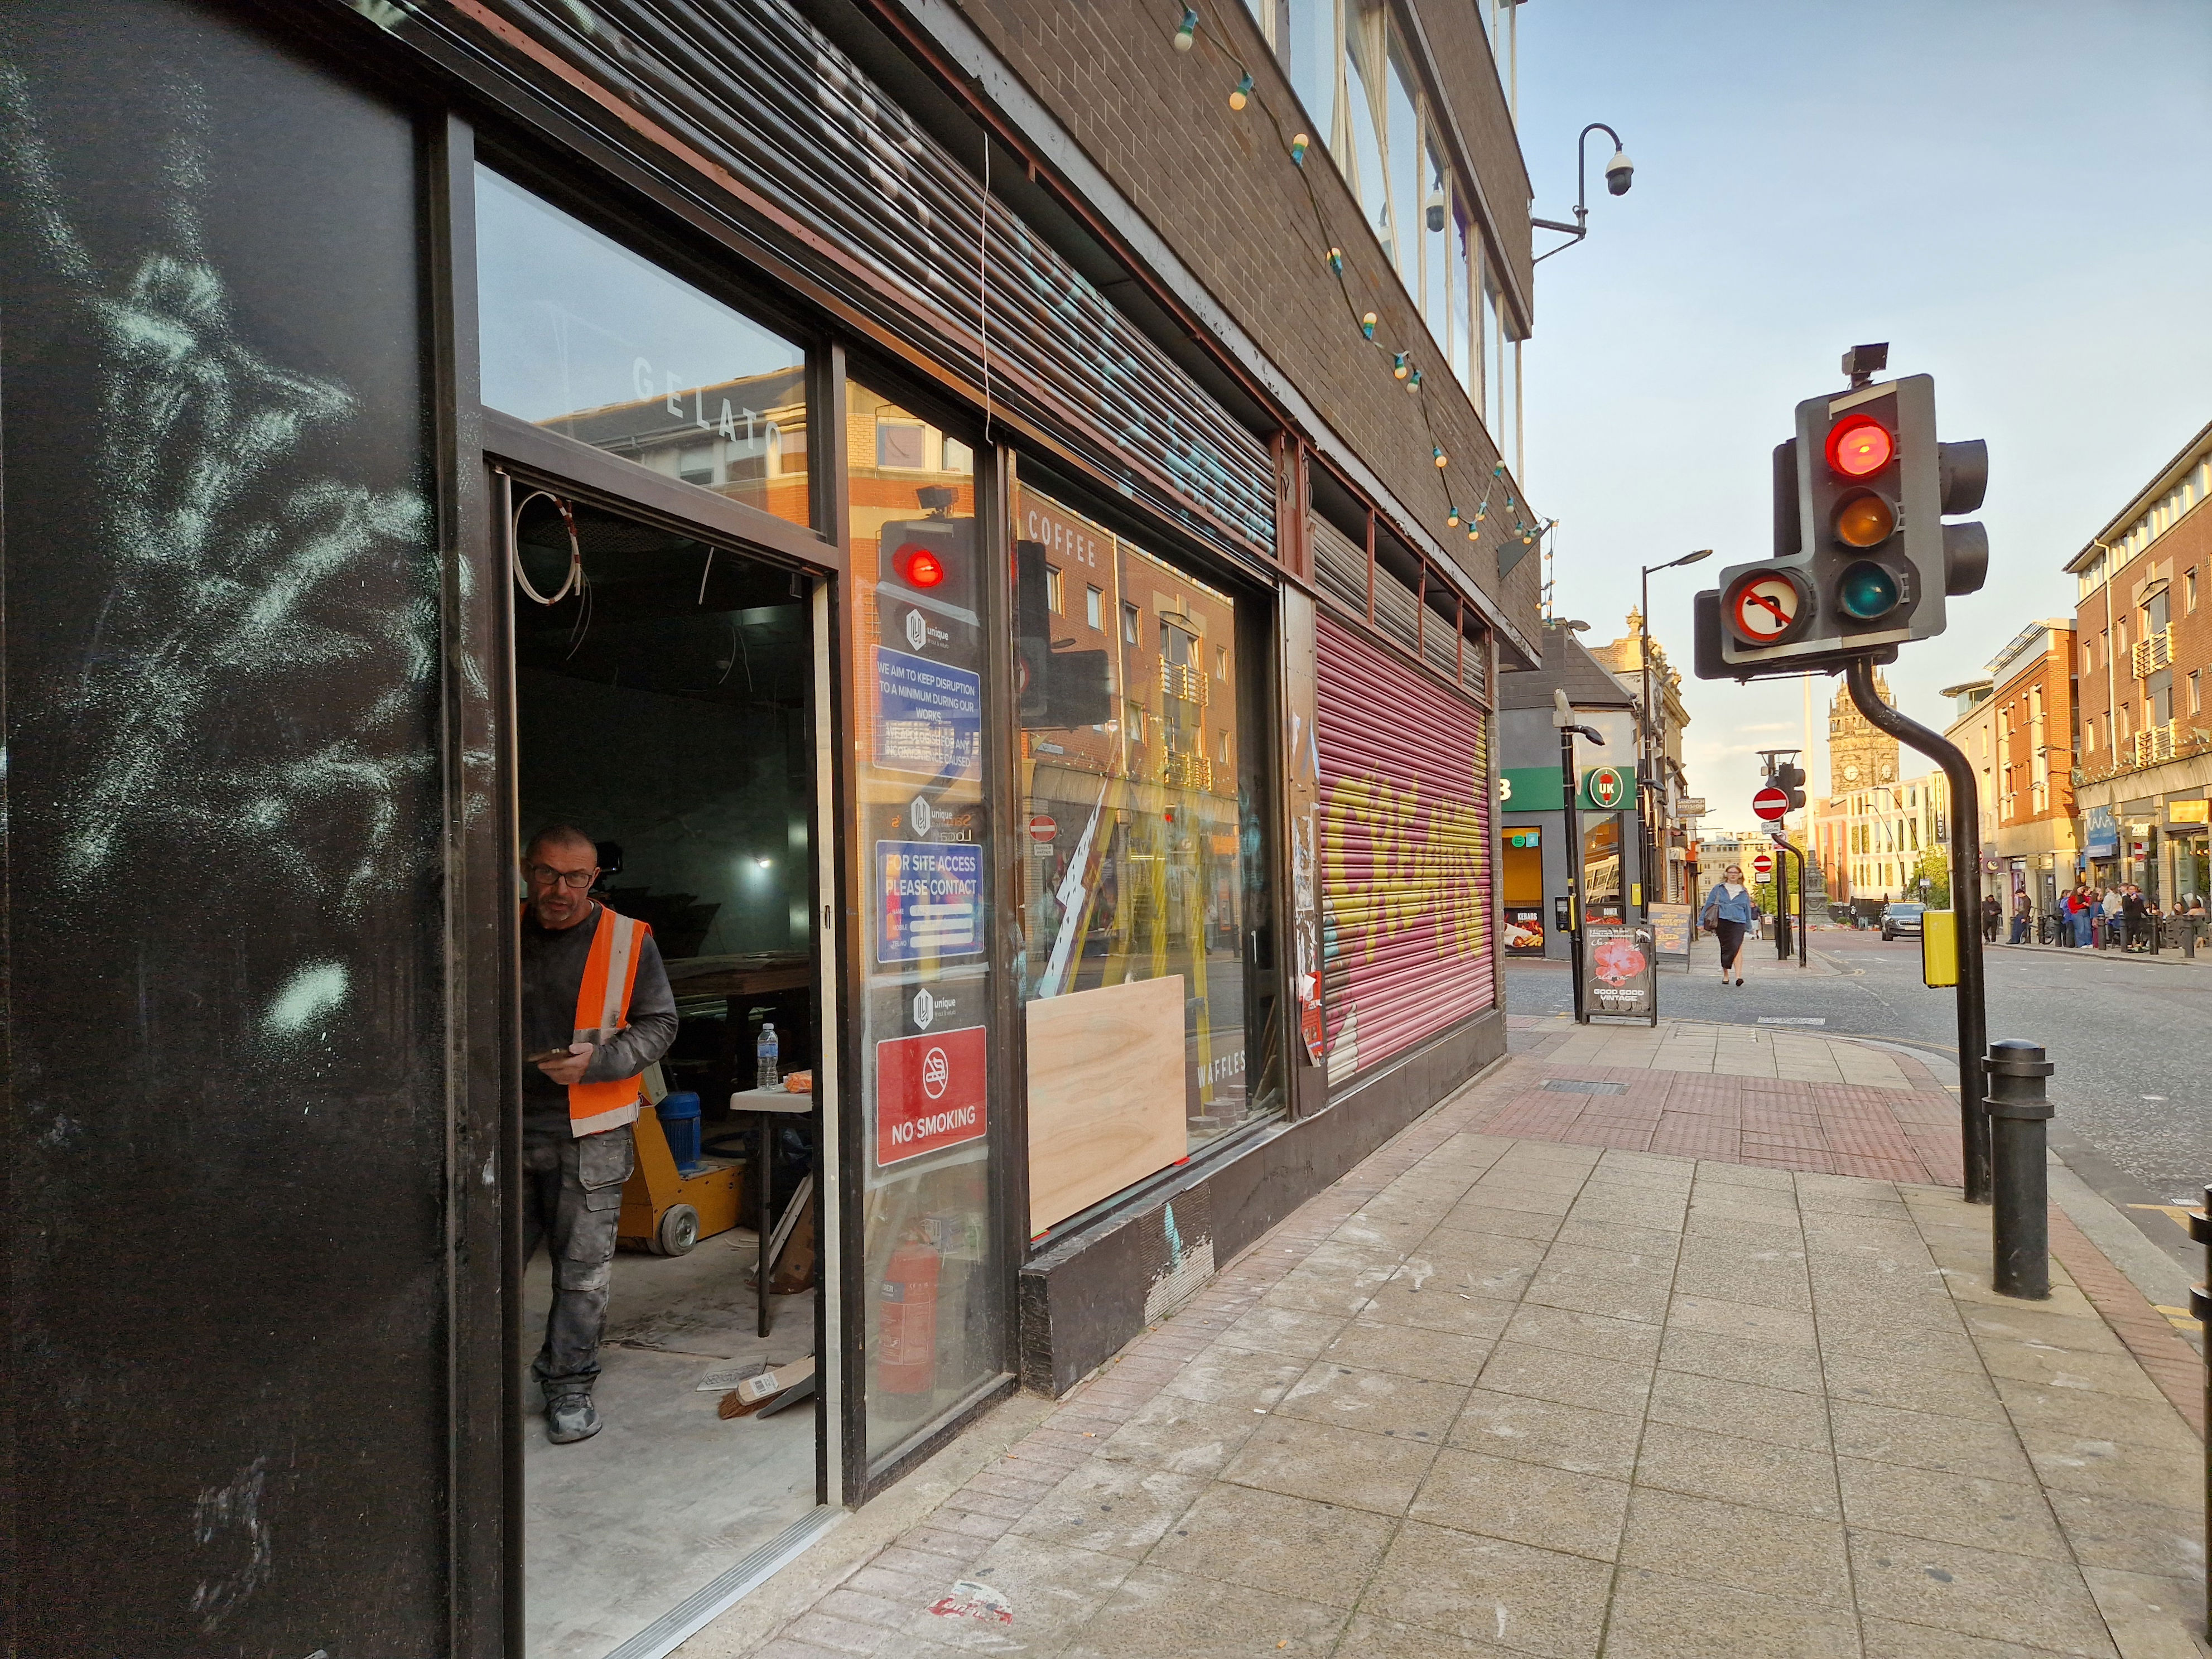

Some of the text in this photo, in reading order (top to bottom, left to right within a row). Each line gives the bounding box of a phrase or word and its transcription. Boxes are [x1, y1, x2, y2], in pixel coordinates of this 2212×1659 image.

[633, 356, 782, 458] GELATO
[1028, 510, 1096, 568] COFFEE
[927, 626, 949, 640] unique
[878, 661, 975, 696] WE AIM TO KEEP DISRUPTION
[880, 680, 974, 713] TO A MINIMUM DURING OUR
[941, 736, 955, 748] FOR
[956, 739, 970, 751] ANY
[885, 744, 943, 763] INCONVENIENCE
[1598, 783, 1615, 794] UK
[931, 808, 953, 822] unique
[886, 855, 976, 872] FOR SITE ACCESS
[886, 879, 977, 896] PLEASE CONTACT
[1517, 912, 1538, 921] KEBABS
[934, 996, 956, 1010] unique
[1197, 1050, 1246, 1088] WAFFLES
[892, 1105, 976, 1145] NO SMOKING
